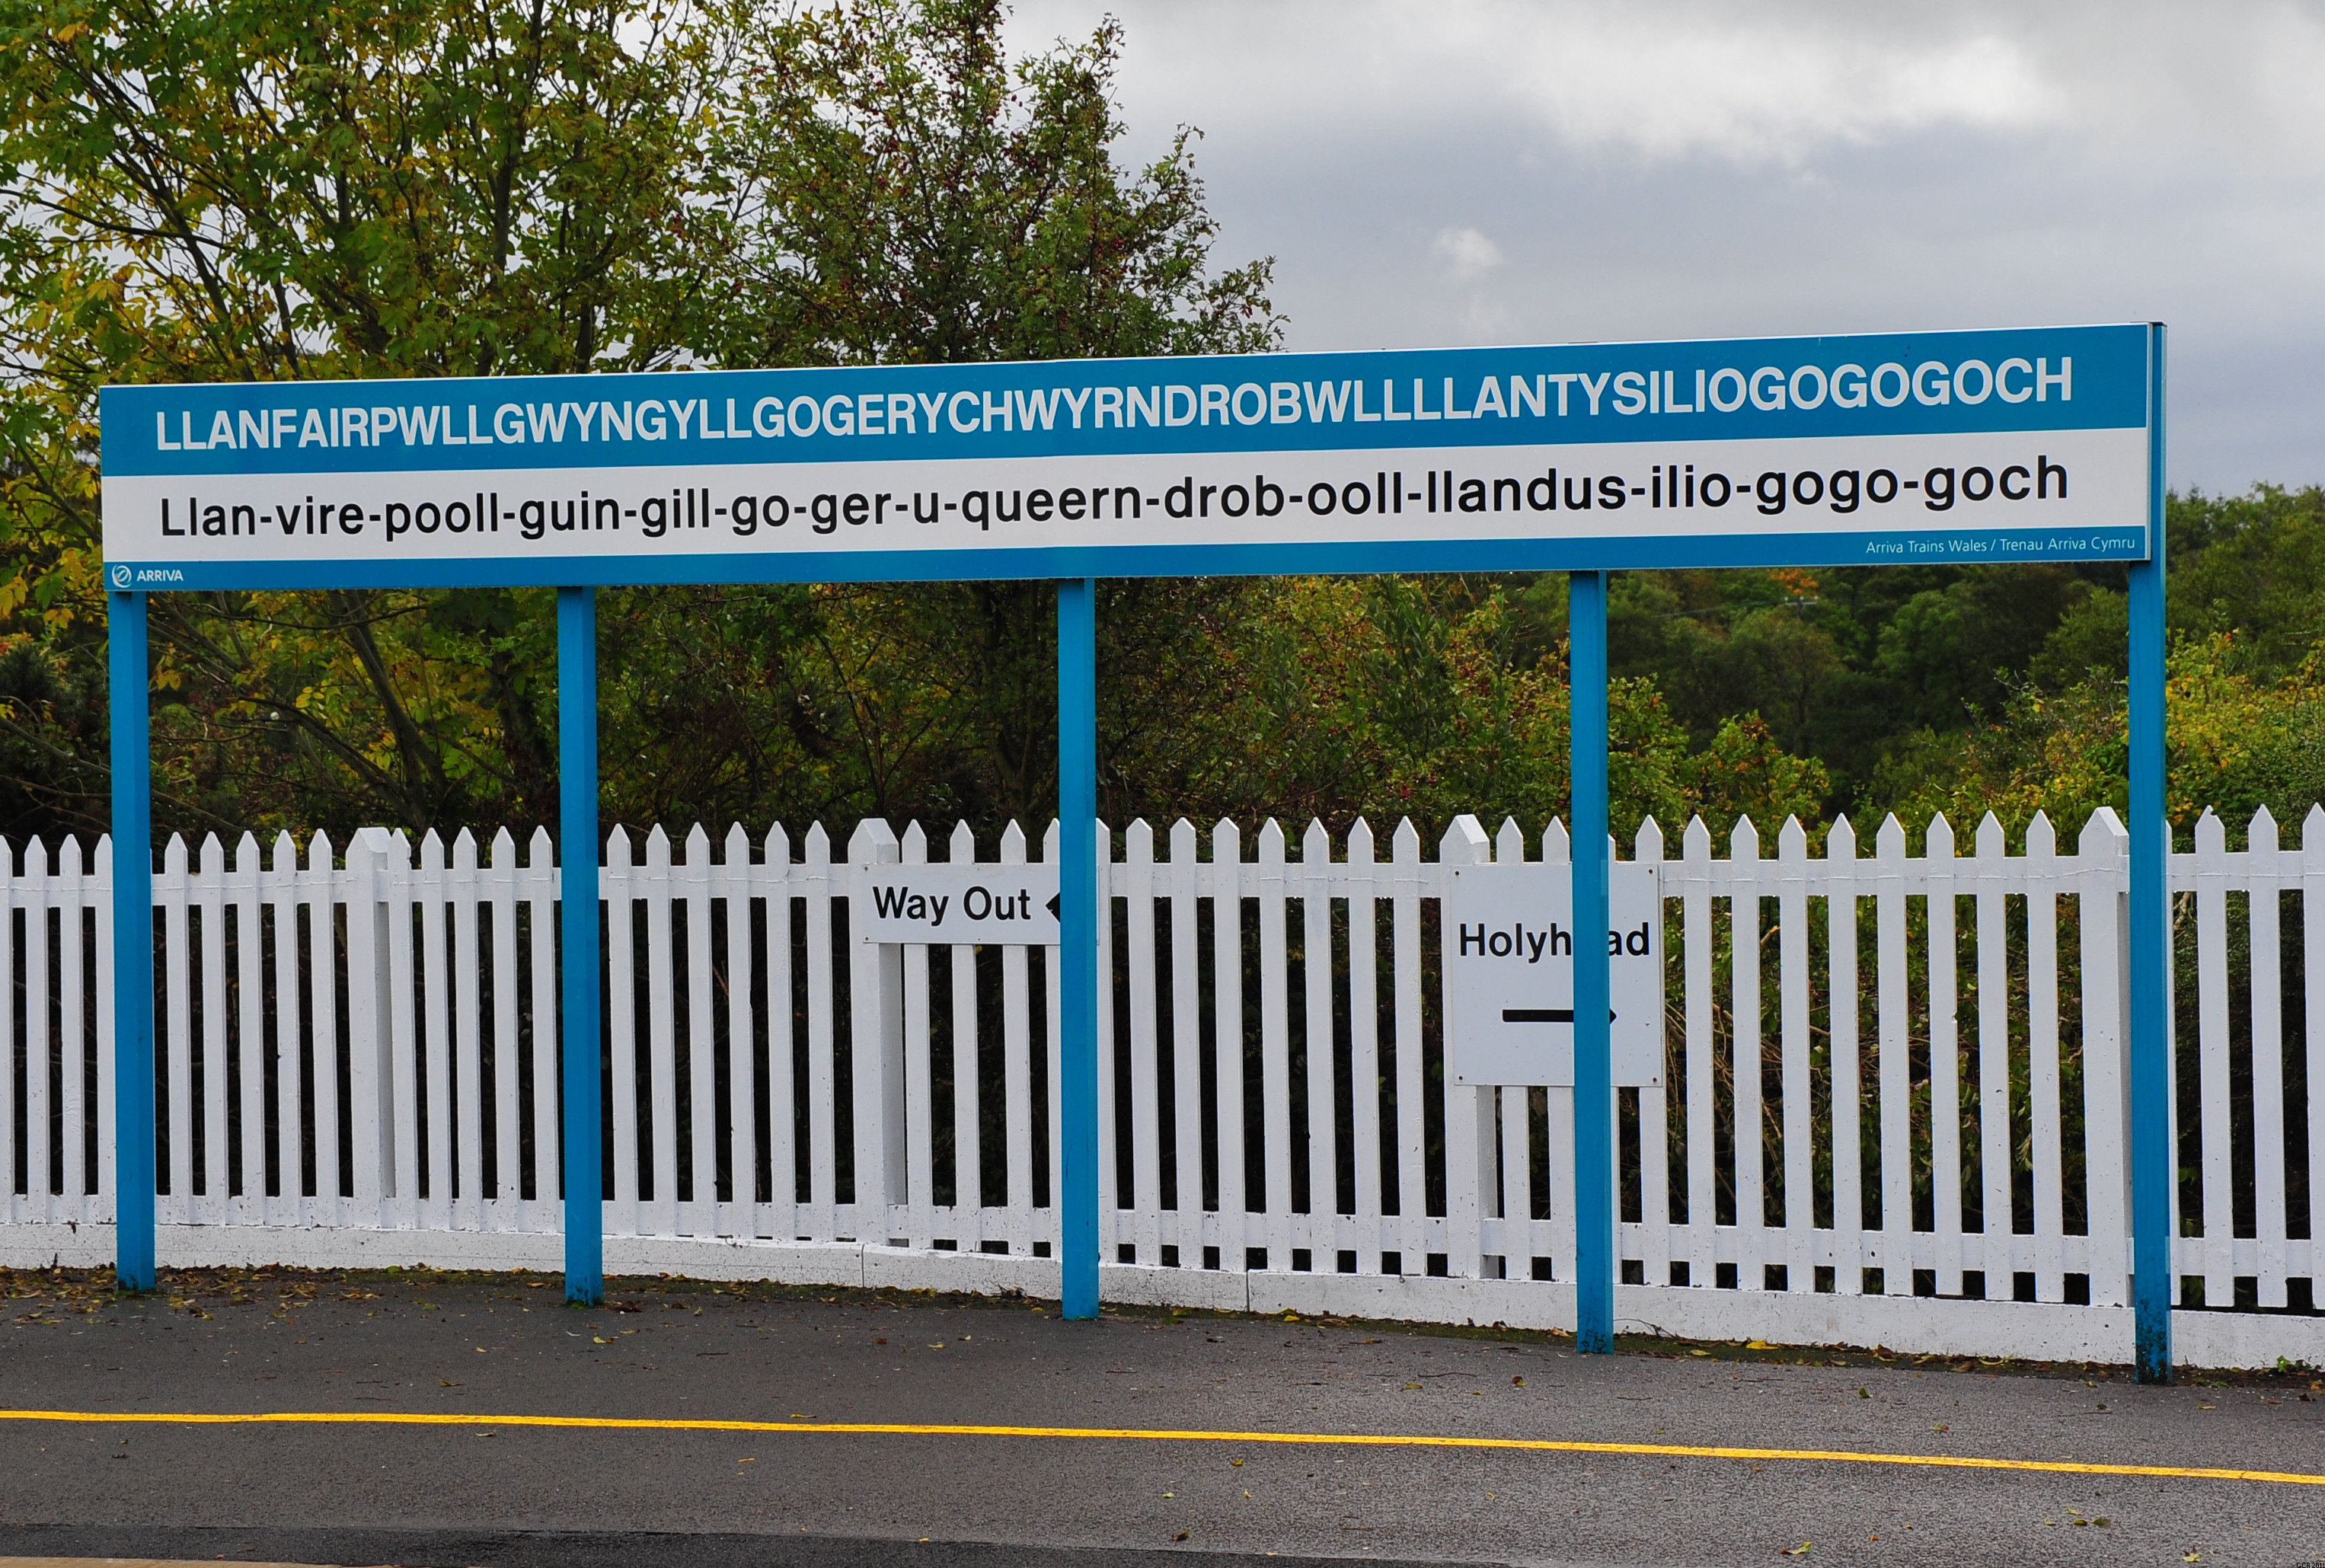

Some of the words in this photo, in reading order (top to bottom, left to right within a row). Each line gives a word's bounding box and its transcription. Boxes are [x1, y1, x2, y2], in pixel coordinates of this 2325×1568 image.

[157, 356, 2072, 451] LLANFAIRPWLLGWYNGYLLGOGERYCHWYRNDROBWLLLLANTYSILIOGOGOGOCH
[161, 455, 2068, 542] Llan-vire-pooll-guin-gill-go-ger-u-queern-drob-ooll-llandus-ilio-gogo-goch
[1866, 541, 1903, 554] Arriva
[1908, 540, 1944, 553] Trains
[1948, 539, 1988, 552] Wales
[1990, 538, 1997, 552] /
[2000, 538, 2043, 551] Trenau
[2048, 538, 2087, 551] Arriva
[2091, 536, 2135, 552] Cymru
[136, 570, 184, 582] ARRIVA
[873, 886, 950, 927] Way
[963, 886, 1031, 921] Out
[1459, 922, 1650, 963] Holyhad
